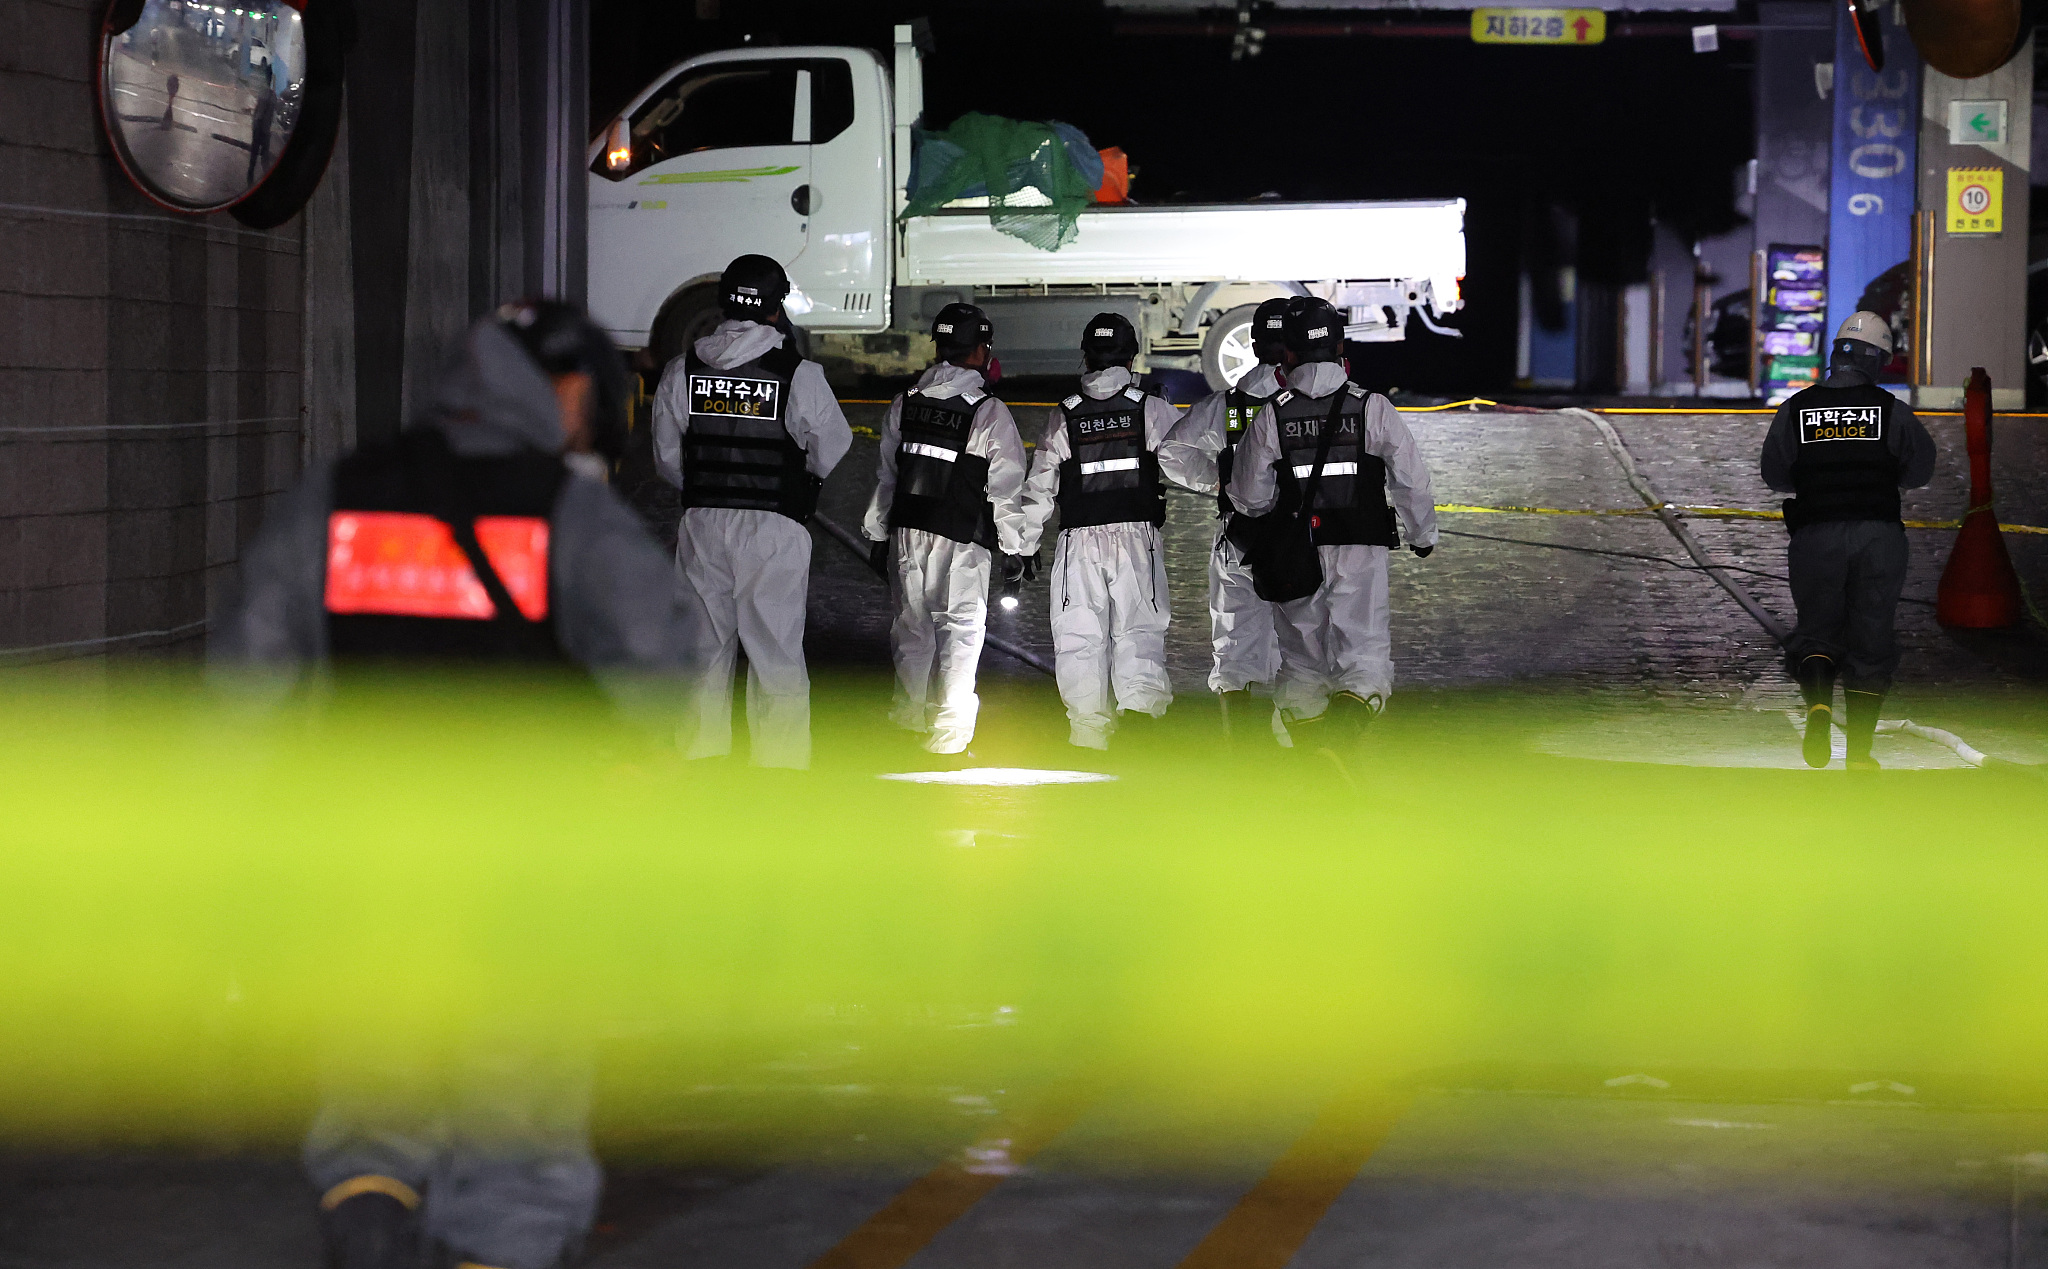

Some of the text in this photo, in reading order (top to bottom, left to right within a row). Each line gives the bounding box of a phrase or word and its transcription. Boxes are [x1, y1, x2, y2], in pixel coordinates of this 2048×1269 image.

[1486, 16, 1564, 37] 지하2층
[1966, 190, 1985, 206] 10
[695, 379, 774, 402] 과학수사
[703, 399, 761, 416] POLICE
[1079, 415, 1132, 434] 인천소방
[1805, 409, 1877, 426] 과학수사
[1285, 417, 1356, 438] 화재사
[1815, 426, 1867, 439] POLICE
